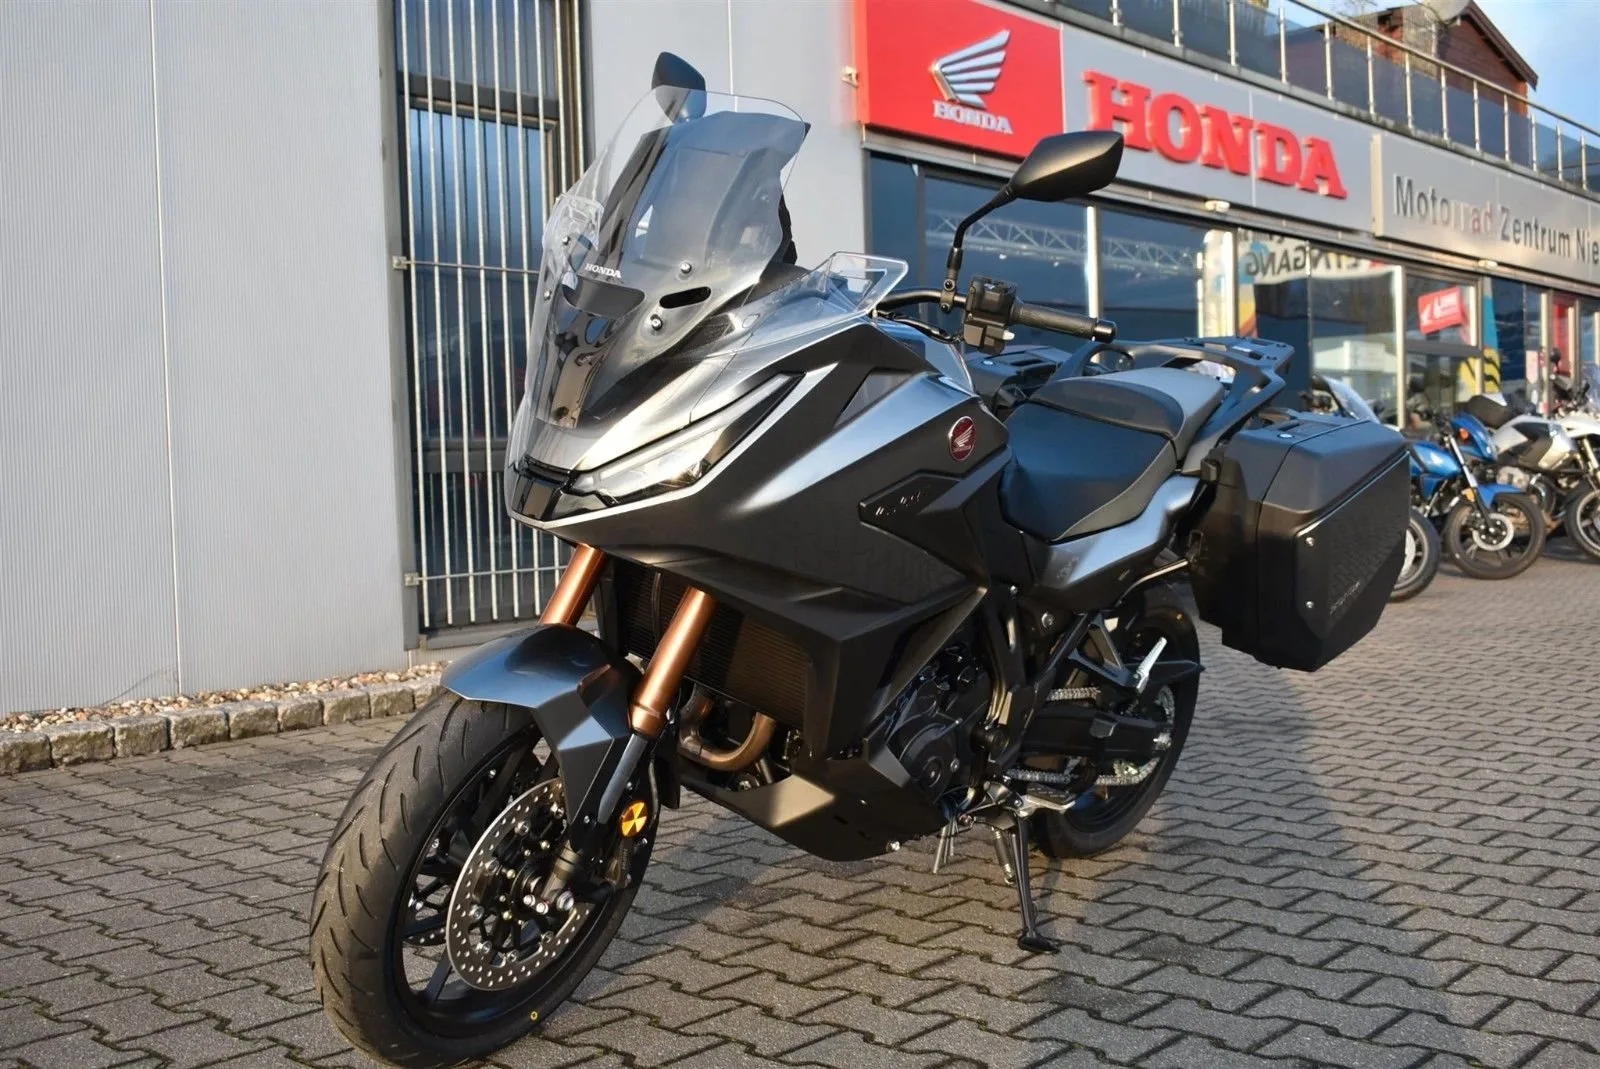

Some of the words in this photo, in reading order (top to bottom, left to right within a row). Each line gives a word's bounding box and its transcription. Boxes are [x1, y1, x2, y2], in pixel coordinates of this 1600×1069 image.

[933, 99, 1014, 134] HONDA
[1082, 70, 1347, 199] HONDA
[1500, 206, 1570, 258] Zentrum
[585, 263, 621, 278] HONDA
